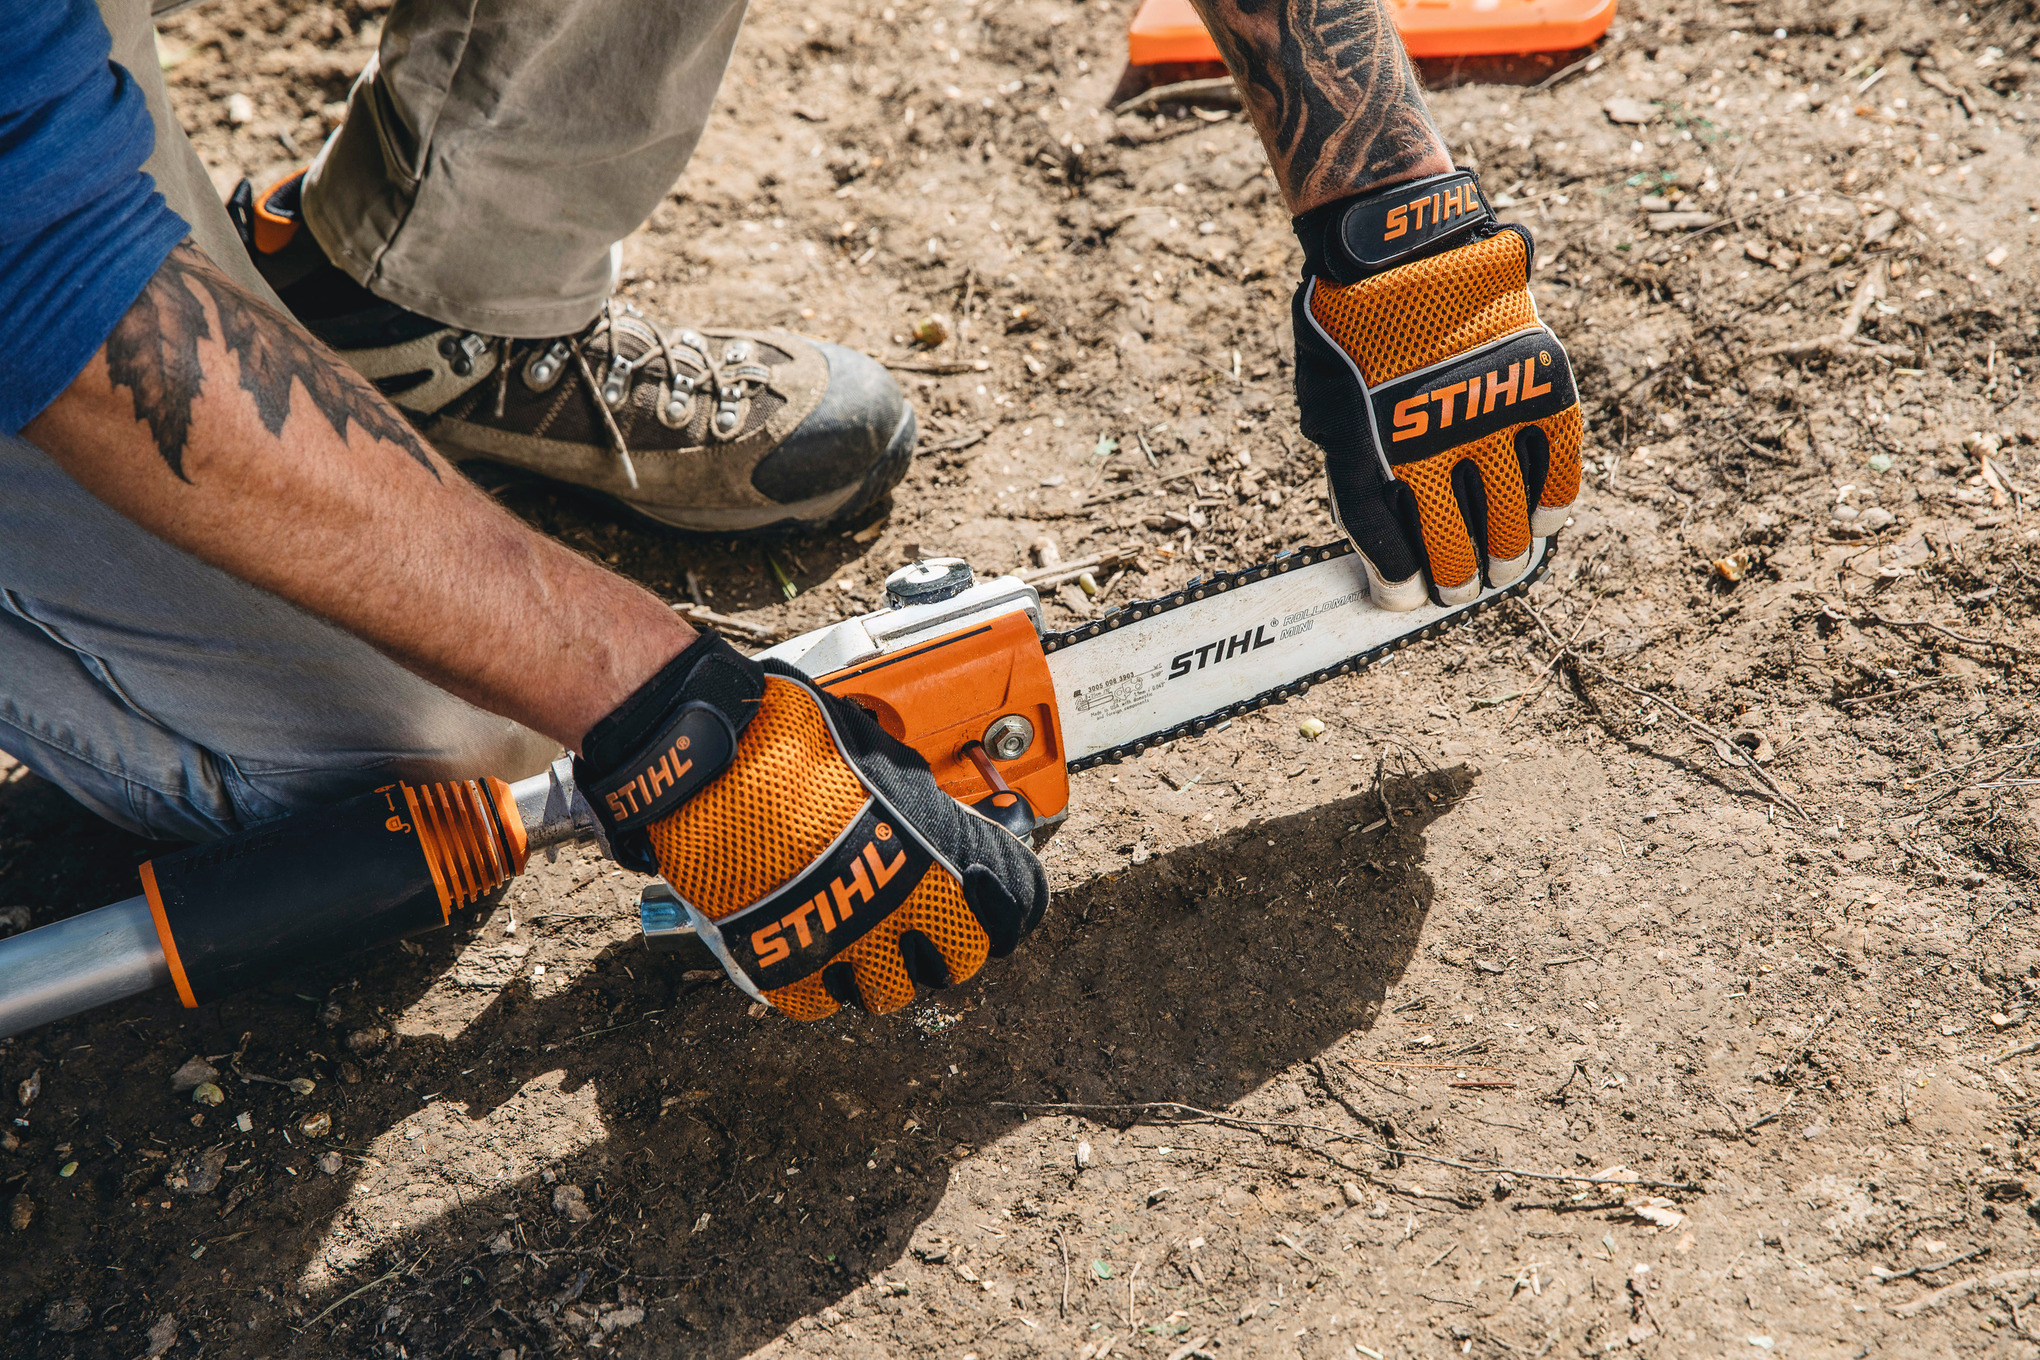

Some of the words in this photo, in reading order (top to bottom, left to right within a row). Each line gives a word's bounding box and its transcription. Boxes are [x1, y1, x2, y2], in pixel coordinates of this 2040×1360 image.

[1384, 184, 1479, 241] STIHL
[1392, 357, 1551, 442] STIHL
[1168, 624, 1275, 680] STIHL
[1280, 620, 1314, 640] MINI
[1088, 682, 1103, 692] 3005
[1105, 678, 1117, 687] 008
[1119, 671, 1134, 682] 3903
[605, 747, 693, 822] STIHL
[751, 840, 907, 968] STIHL
